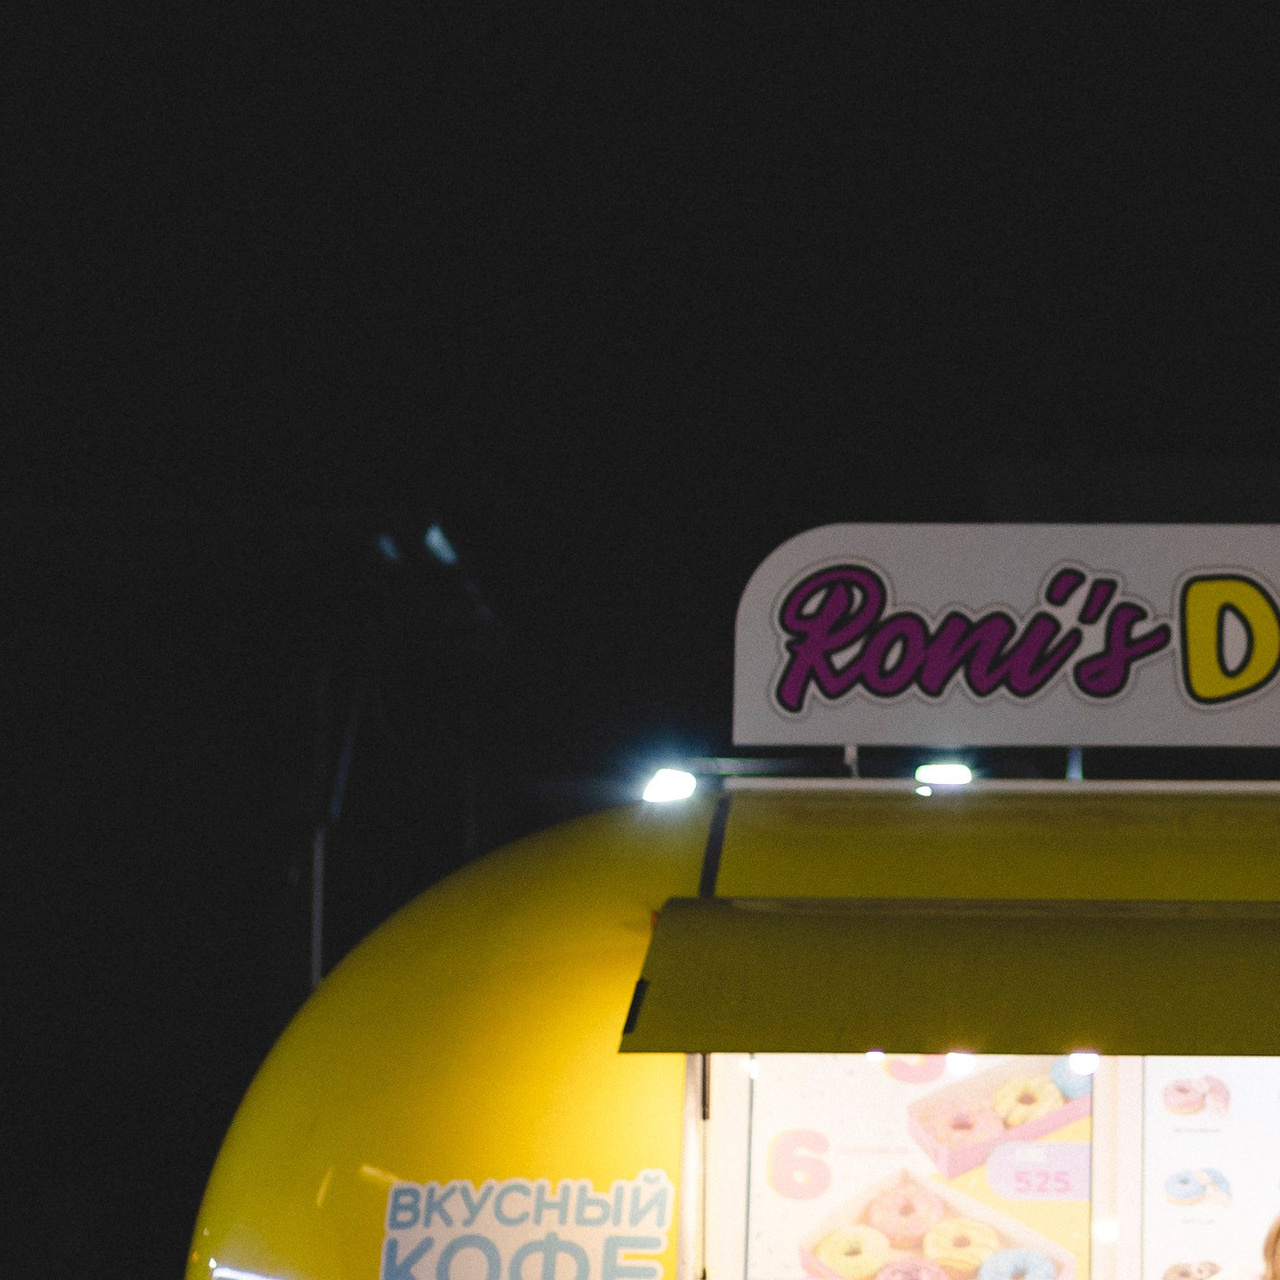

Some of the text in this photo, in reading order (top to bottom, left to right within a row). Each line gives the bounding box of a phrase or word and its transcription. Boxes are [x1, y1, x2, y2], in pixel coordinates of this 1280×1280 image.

[776, 564, 1171, 713] Roni's
[386, 1173, 670, 1231] ВКУСНЫЙ
[1014, 1168, 1072, 1195] 525
